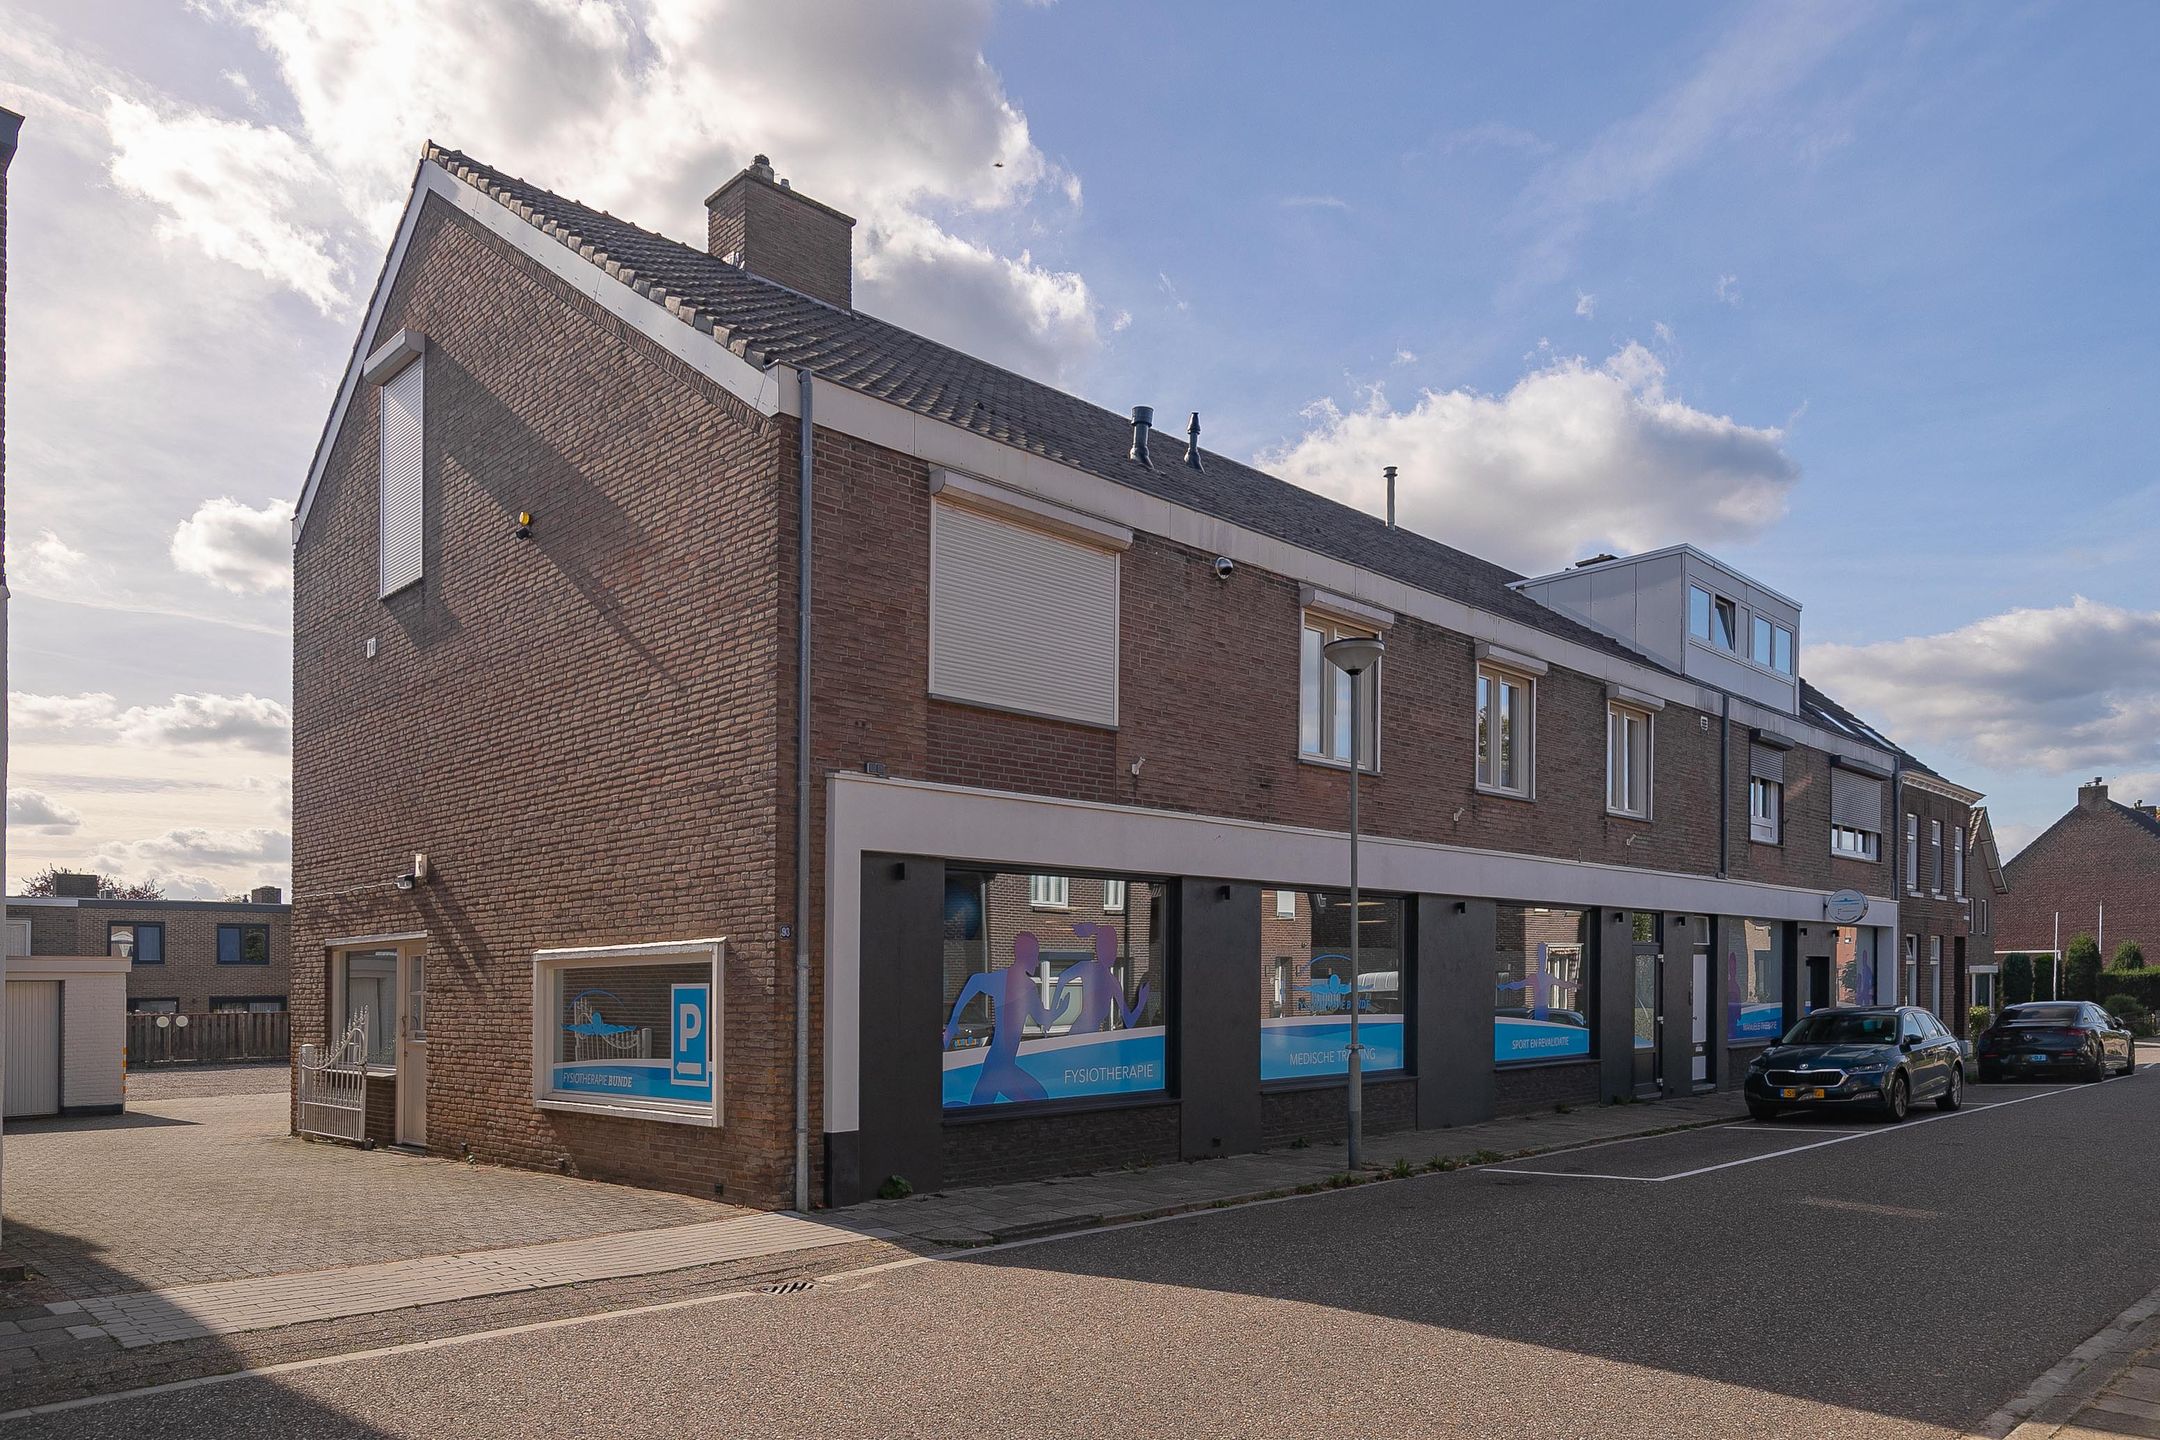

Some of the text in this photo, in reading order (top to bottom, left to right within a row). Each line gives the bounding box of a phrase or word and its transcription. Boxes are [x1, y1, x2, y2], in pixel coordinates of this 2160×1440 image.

[679, 1003, 702, 1052] P
[1511, 1039, 1530, 1050] SPORT
[1530, 1038, 1538, 1049] EN
[1289, 1050, 1335, 1066] MEDISCHE
[563, 1072, 633, 1088] FYSIOTHERAPIE BUNDE
[1064, 1063, 1154, 1084] FYSIOTHERAPIE
